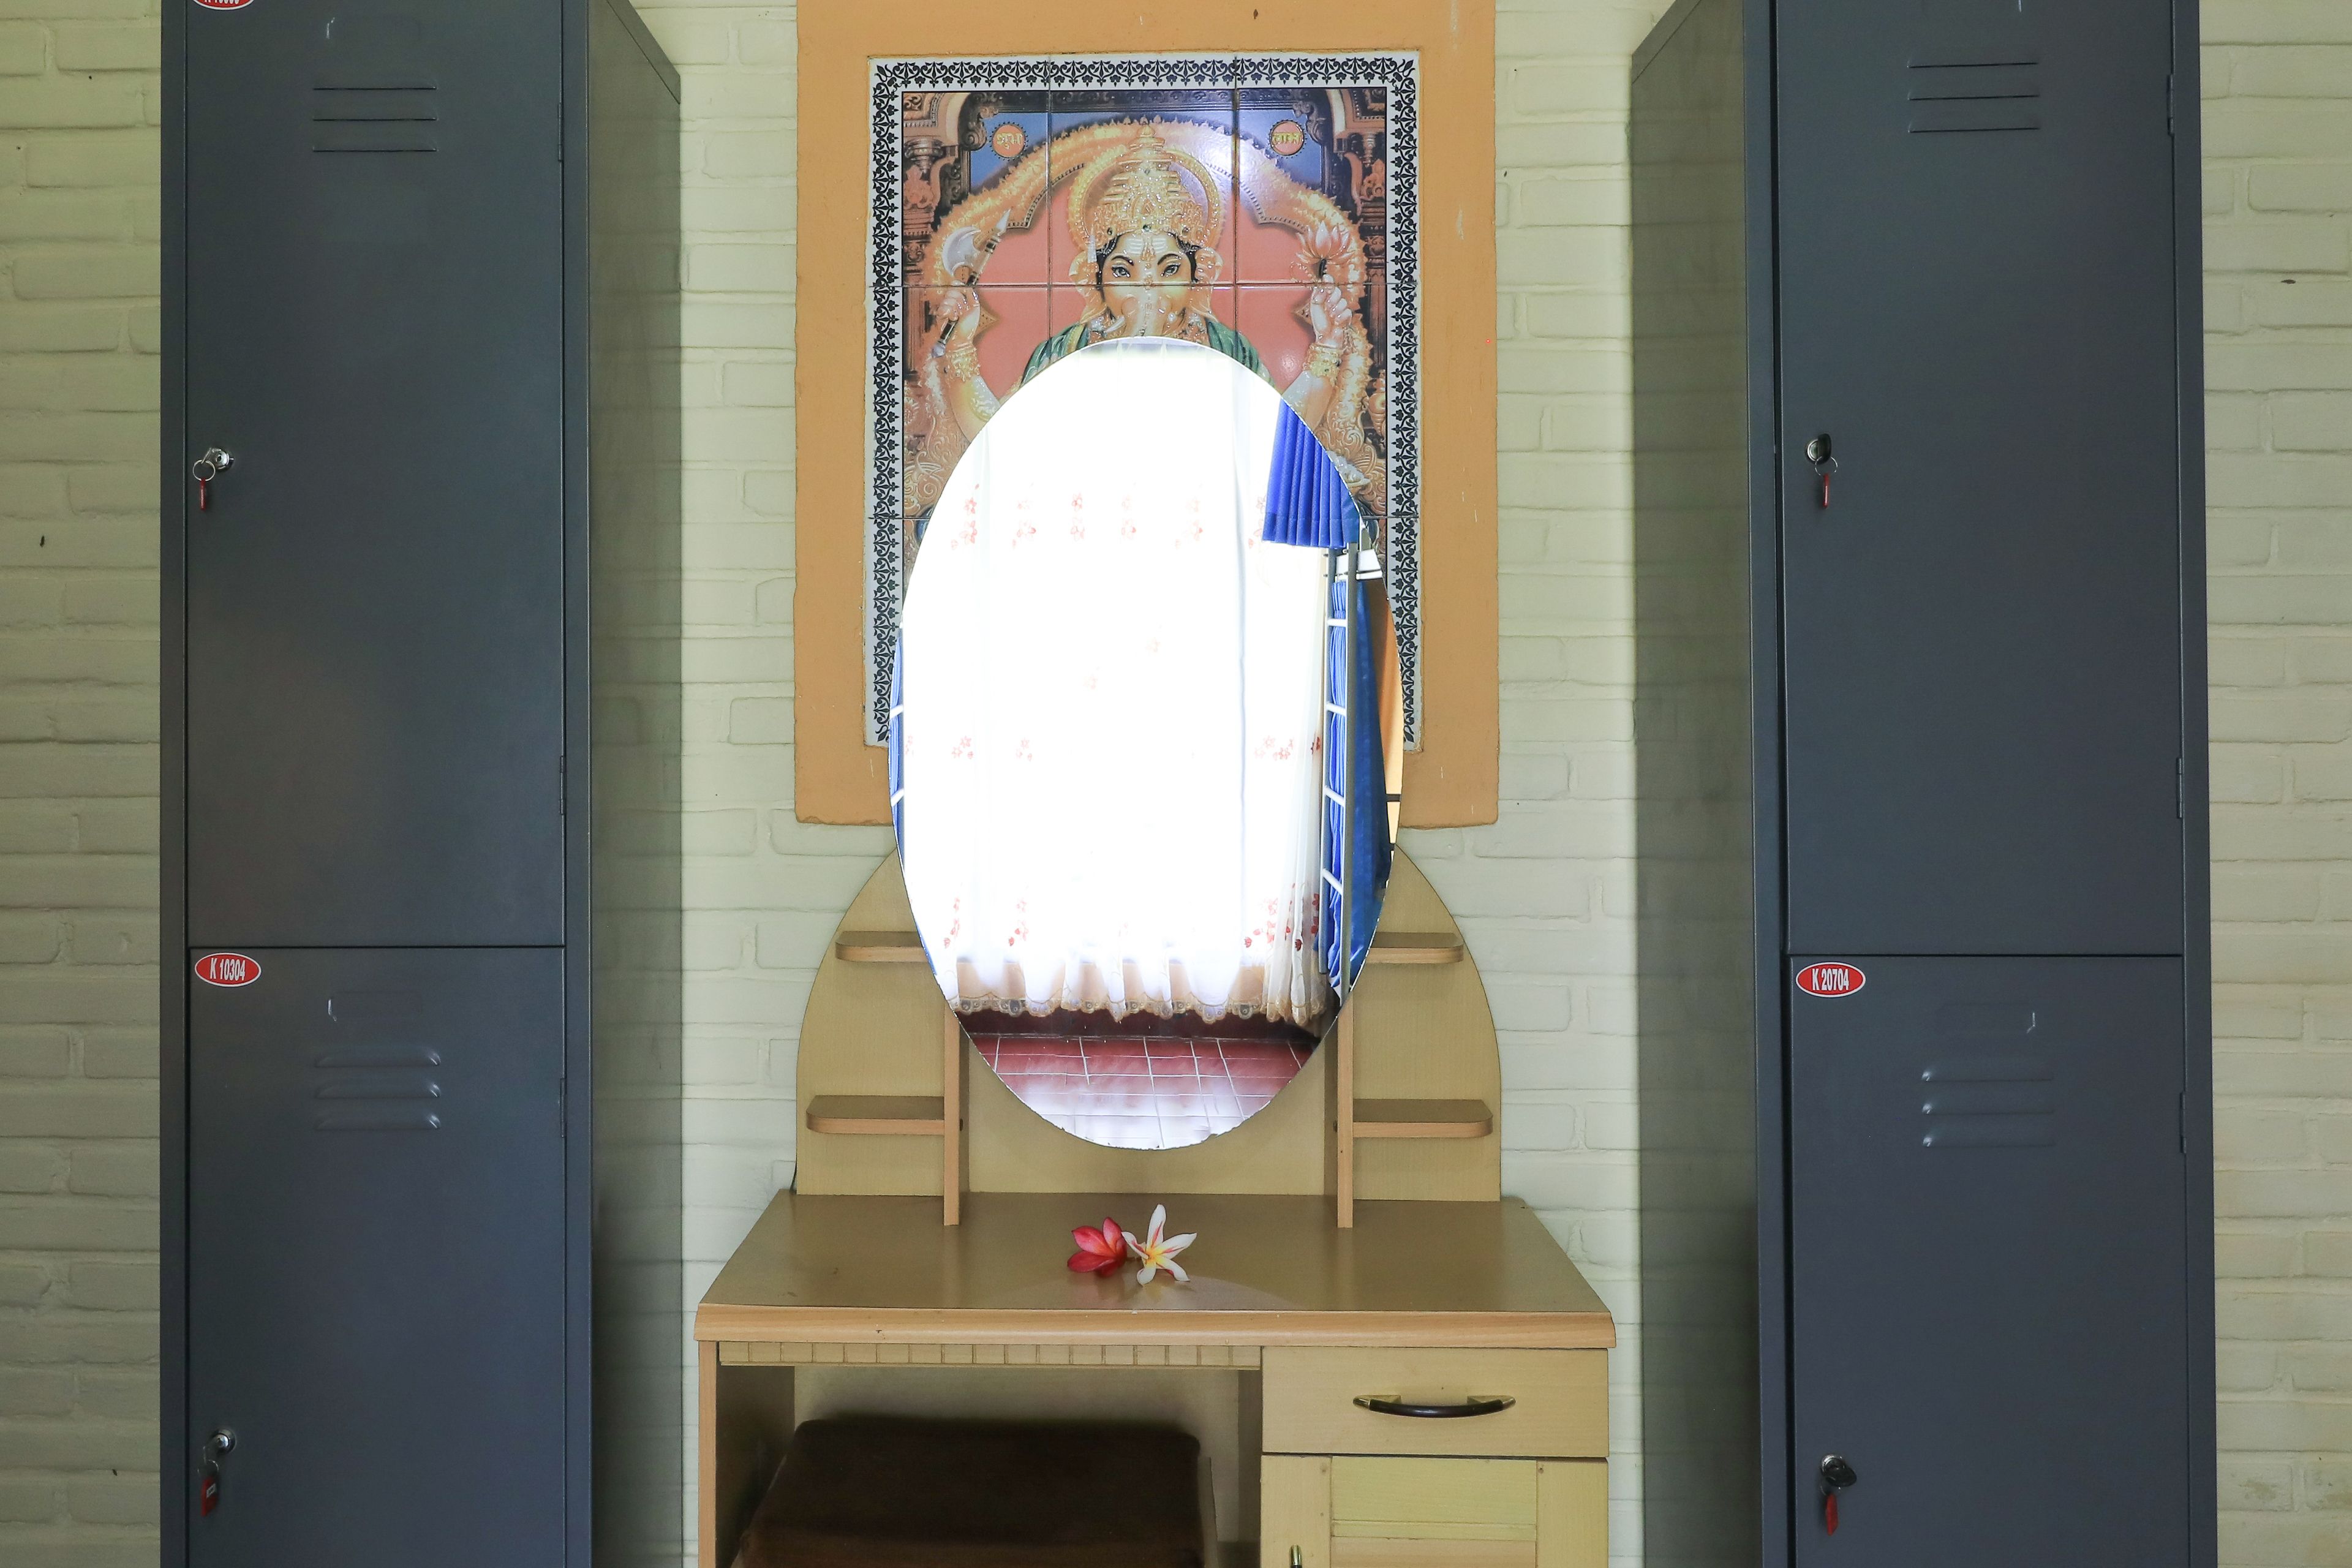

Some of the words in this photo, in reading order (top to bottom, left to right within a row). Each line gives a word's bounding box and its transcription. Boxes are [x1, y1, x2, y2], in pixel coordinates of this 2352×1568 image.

[209, 957, 217, 979] K
[219, 959, 246, 981] 10304
[1812, 968, 1820, 990] K
[1821, 968, 1849, 991] 20704
